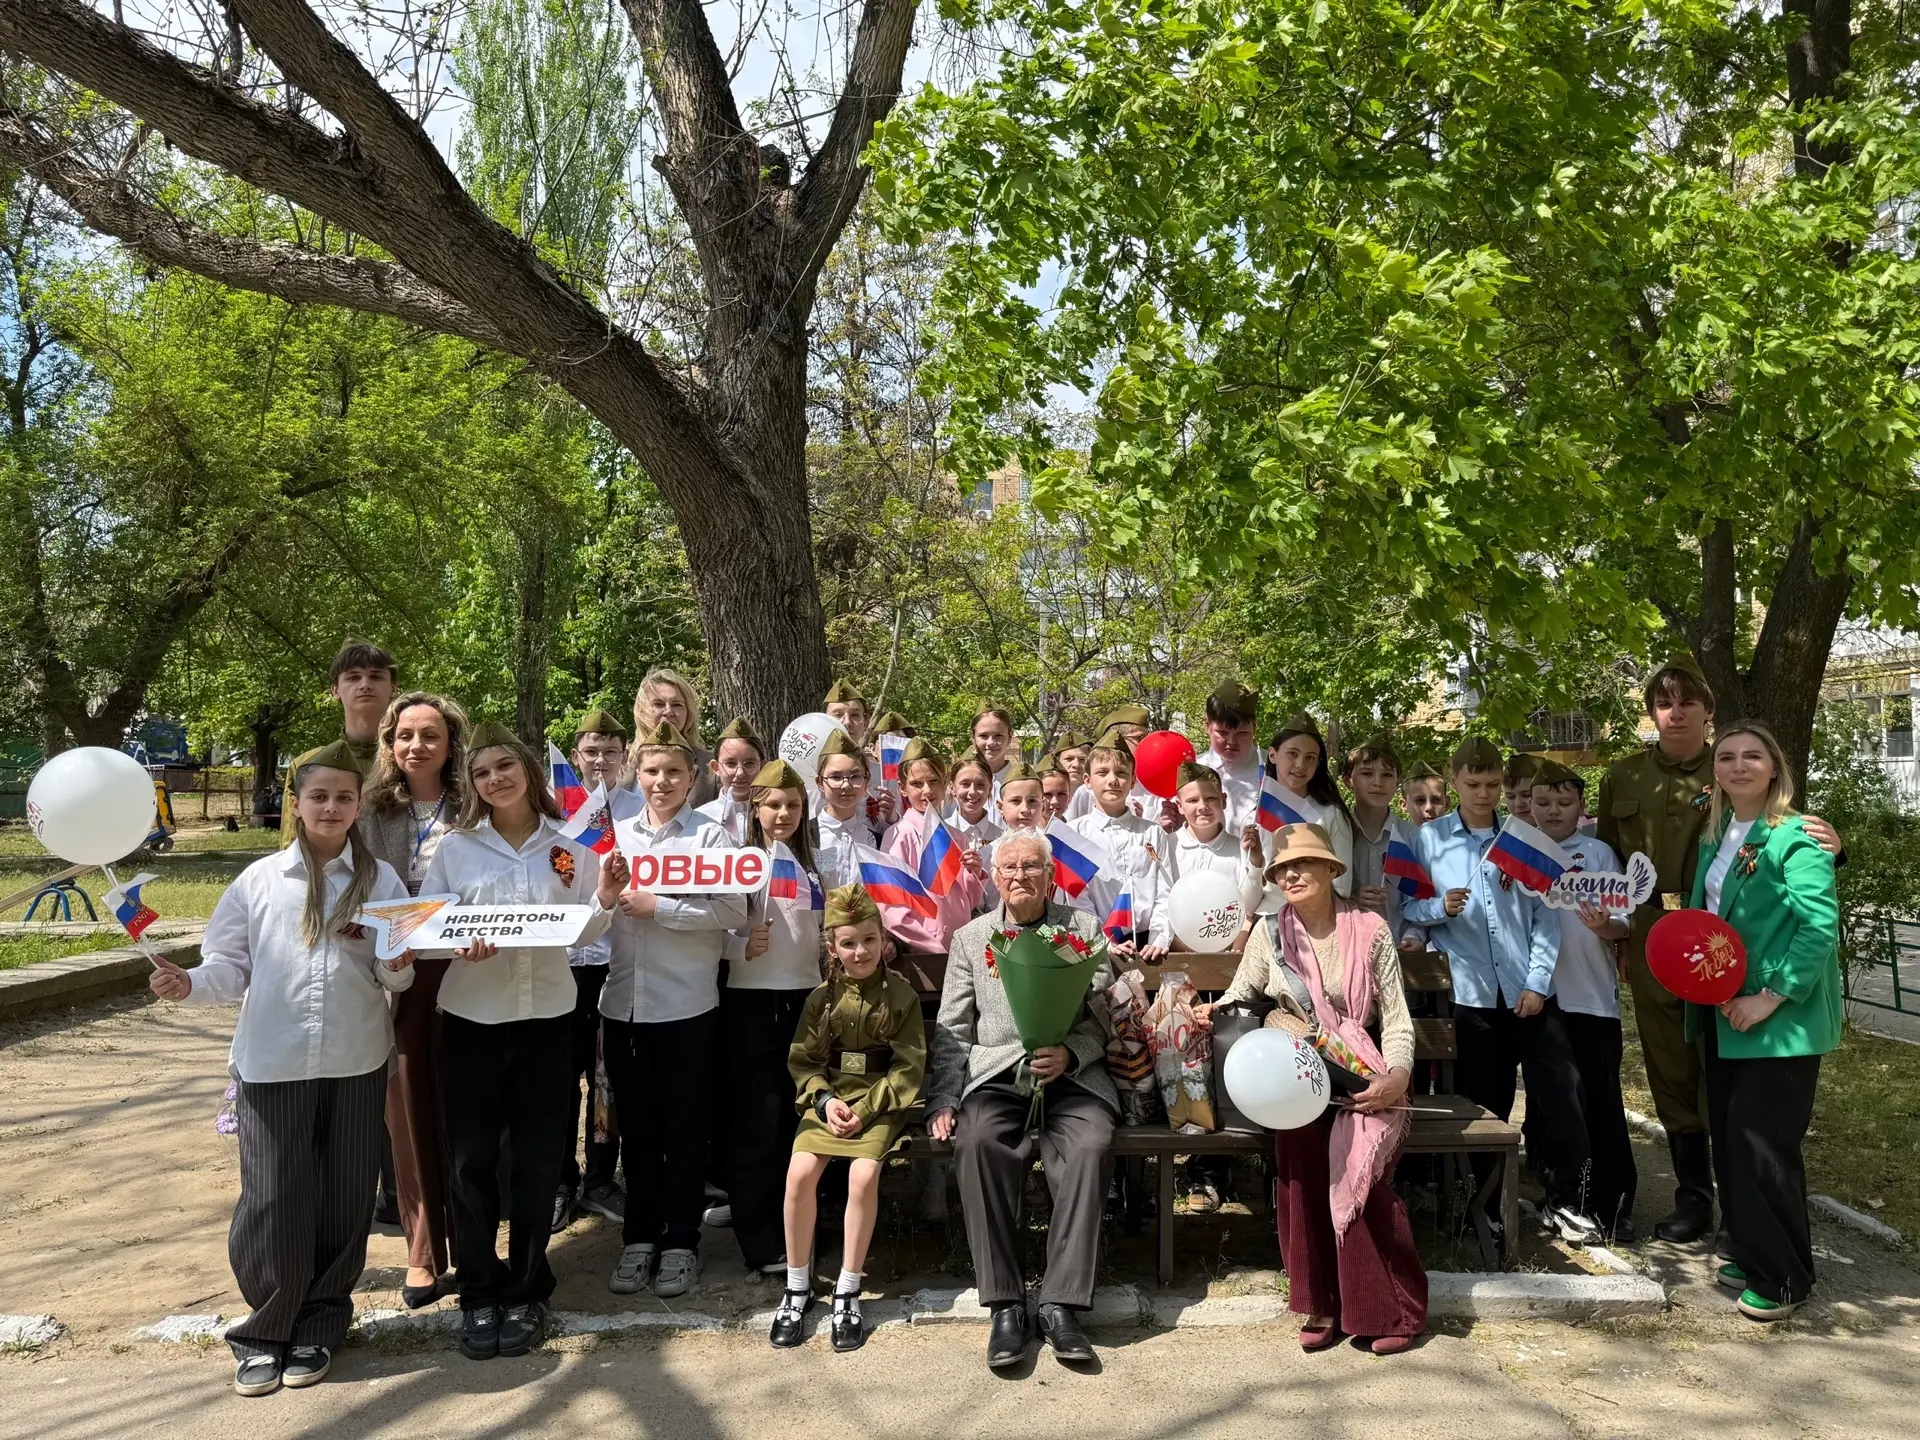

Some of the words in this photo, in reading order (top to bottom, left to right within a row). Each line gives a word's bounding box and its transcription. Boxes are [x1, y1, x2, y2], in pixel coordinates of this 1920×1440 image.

[630, 854, 763, 891] рвые
[1550, 890, 1630, 909] РОССИИ
[444, 912, 566, 925] НАВИГАТОРЫ
[439, 926, 524, 940] ДЕТСТВА
